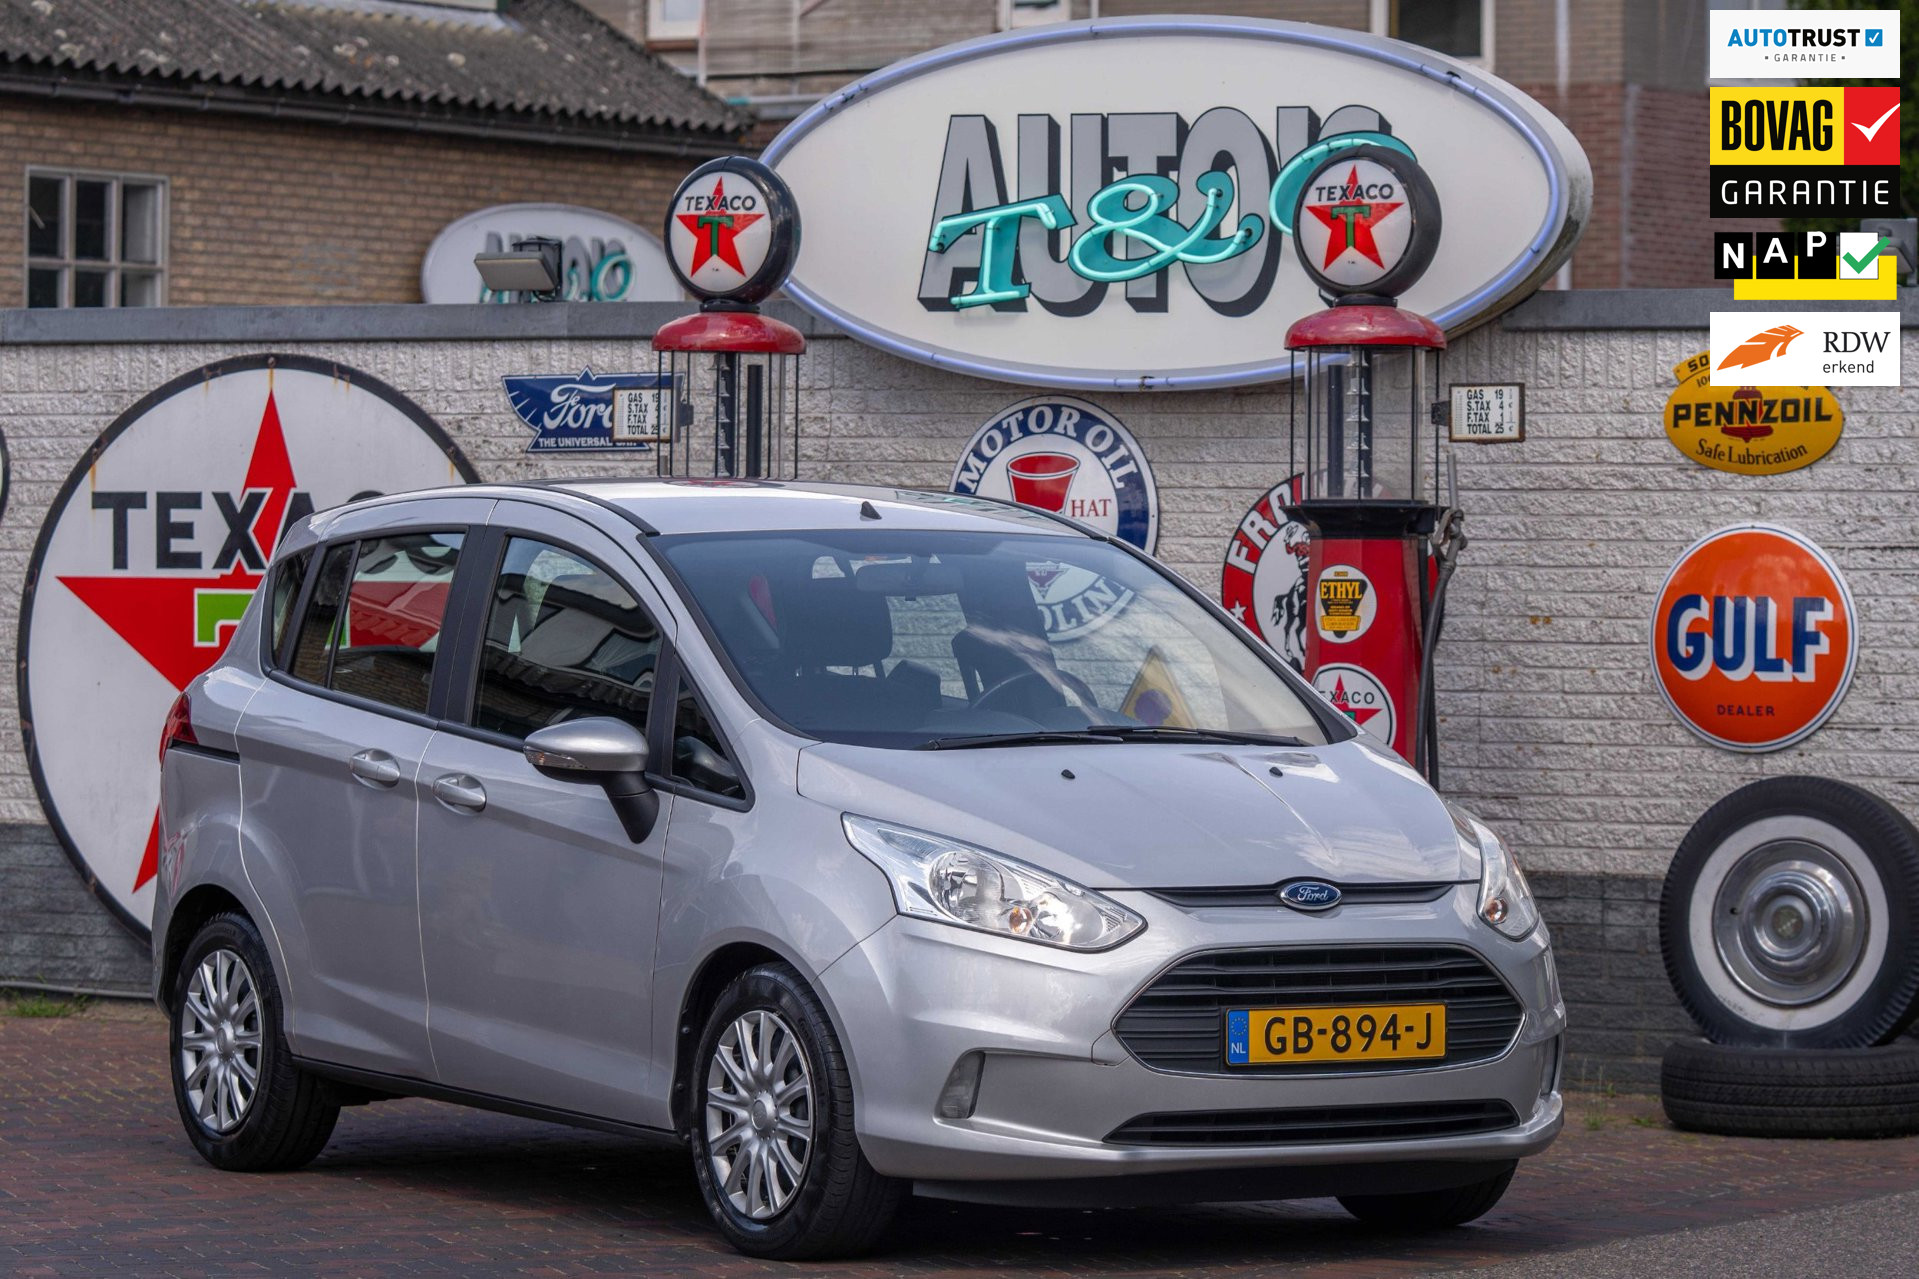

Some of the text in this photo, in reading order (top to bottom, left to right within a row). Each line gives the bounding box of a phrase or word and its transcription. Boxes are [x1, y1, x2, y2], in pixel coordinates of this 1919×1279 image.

[1316, 184, 1394, 202] TEXACO
[685, 195, 757, 212] TEXACO
[627, 393, 643, 403] GAS
[1467, 389, 1504, 400] GAS 19
[627, 403, 648, 414] S.TAX
[1467, 401, 1490, 412] S.TAX
[1499, 402, 1504, 411] 4
[1673, 397, 1833, 428] PENNZOIL
[627, 414, 647, 424] F.TAX
[1467, 412, 1490, 423] F.TAX
[627, 425, 648, 435] TOTAL
[1467, 424, 1492, 434] TOTAL
[1495, 423, 1504, 434] 25
[539, 437, 557, 448] THE
[558, 437, 614, 447] UNIVERSAL
[958, 405, 1138, 493] MOTOR OIL
[1696, 438, 1808, 465] Safe Lubrication
[1071, 499, 1111, 517] HAT
[1320, 581, 1363, 599] ETHYL
[1667, 593, 1834, 682] GULF
[1319, 691, 1375, 705] XACO
[1716, 704, 1775, 717] DEALER
[1297, 886, 1329, 901] Ford
[1264, 1012, 1432, 1055] GB-894-J
[1231, 1042, 1246, 1054] NL
